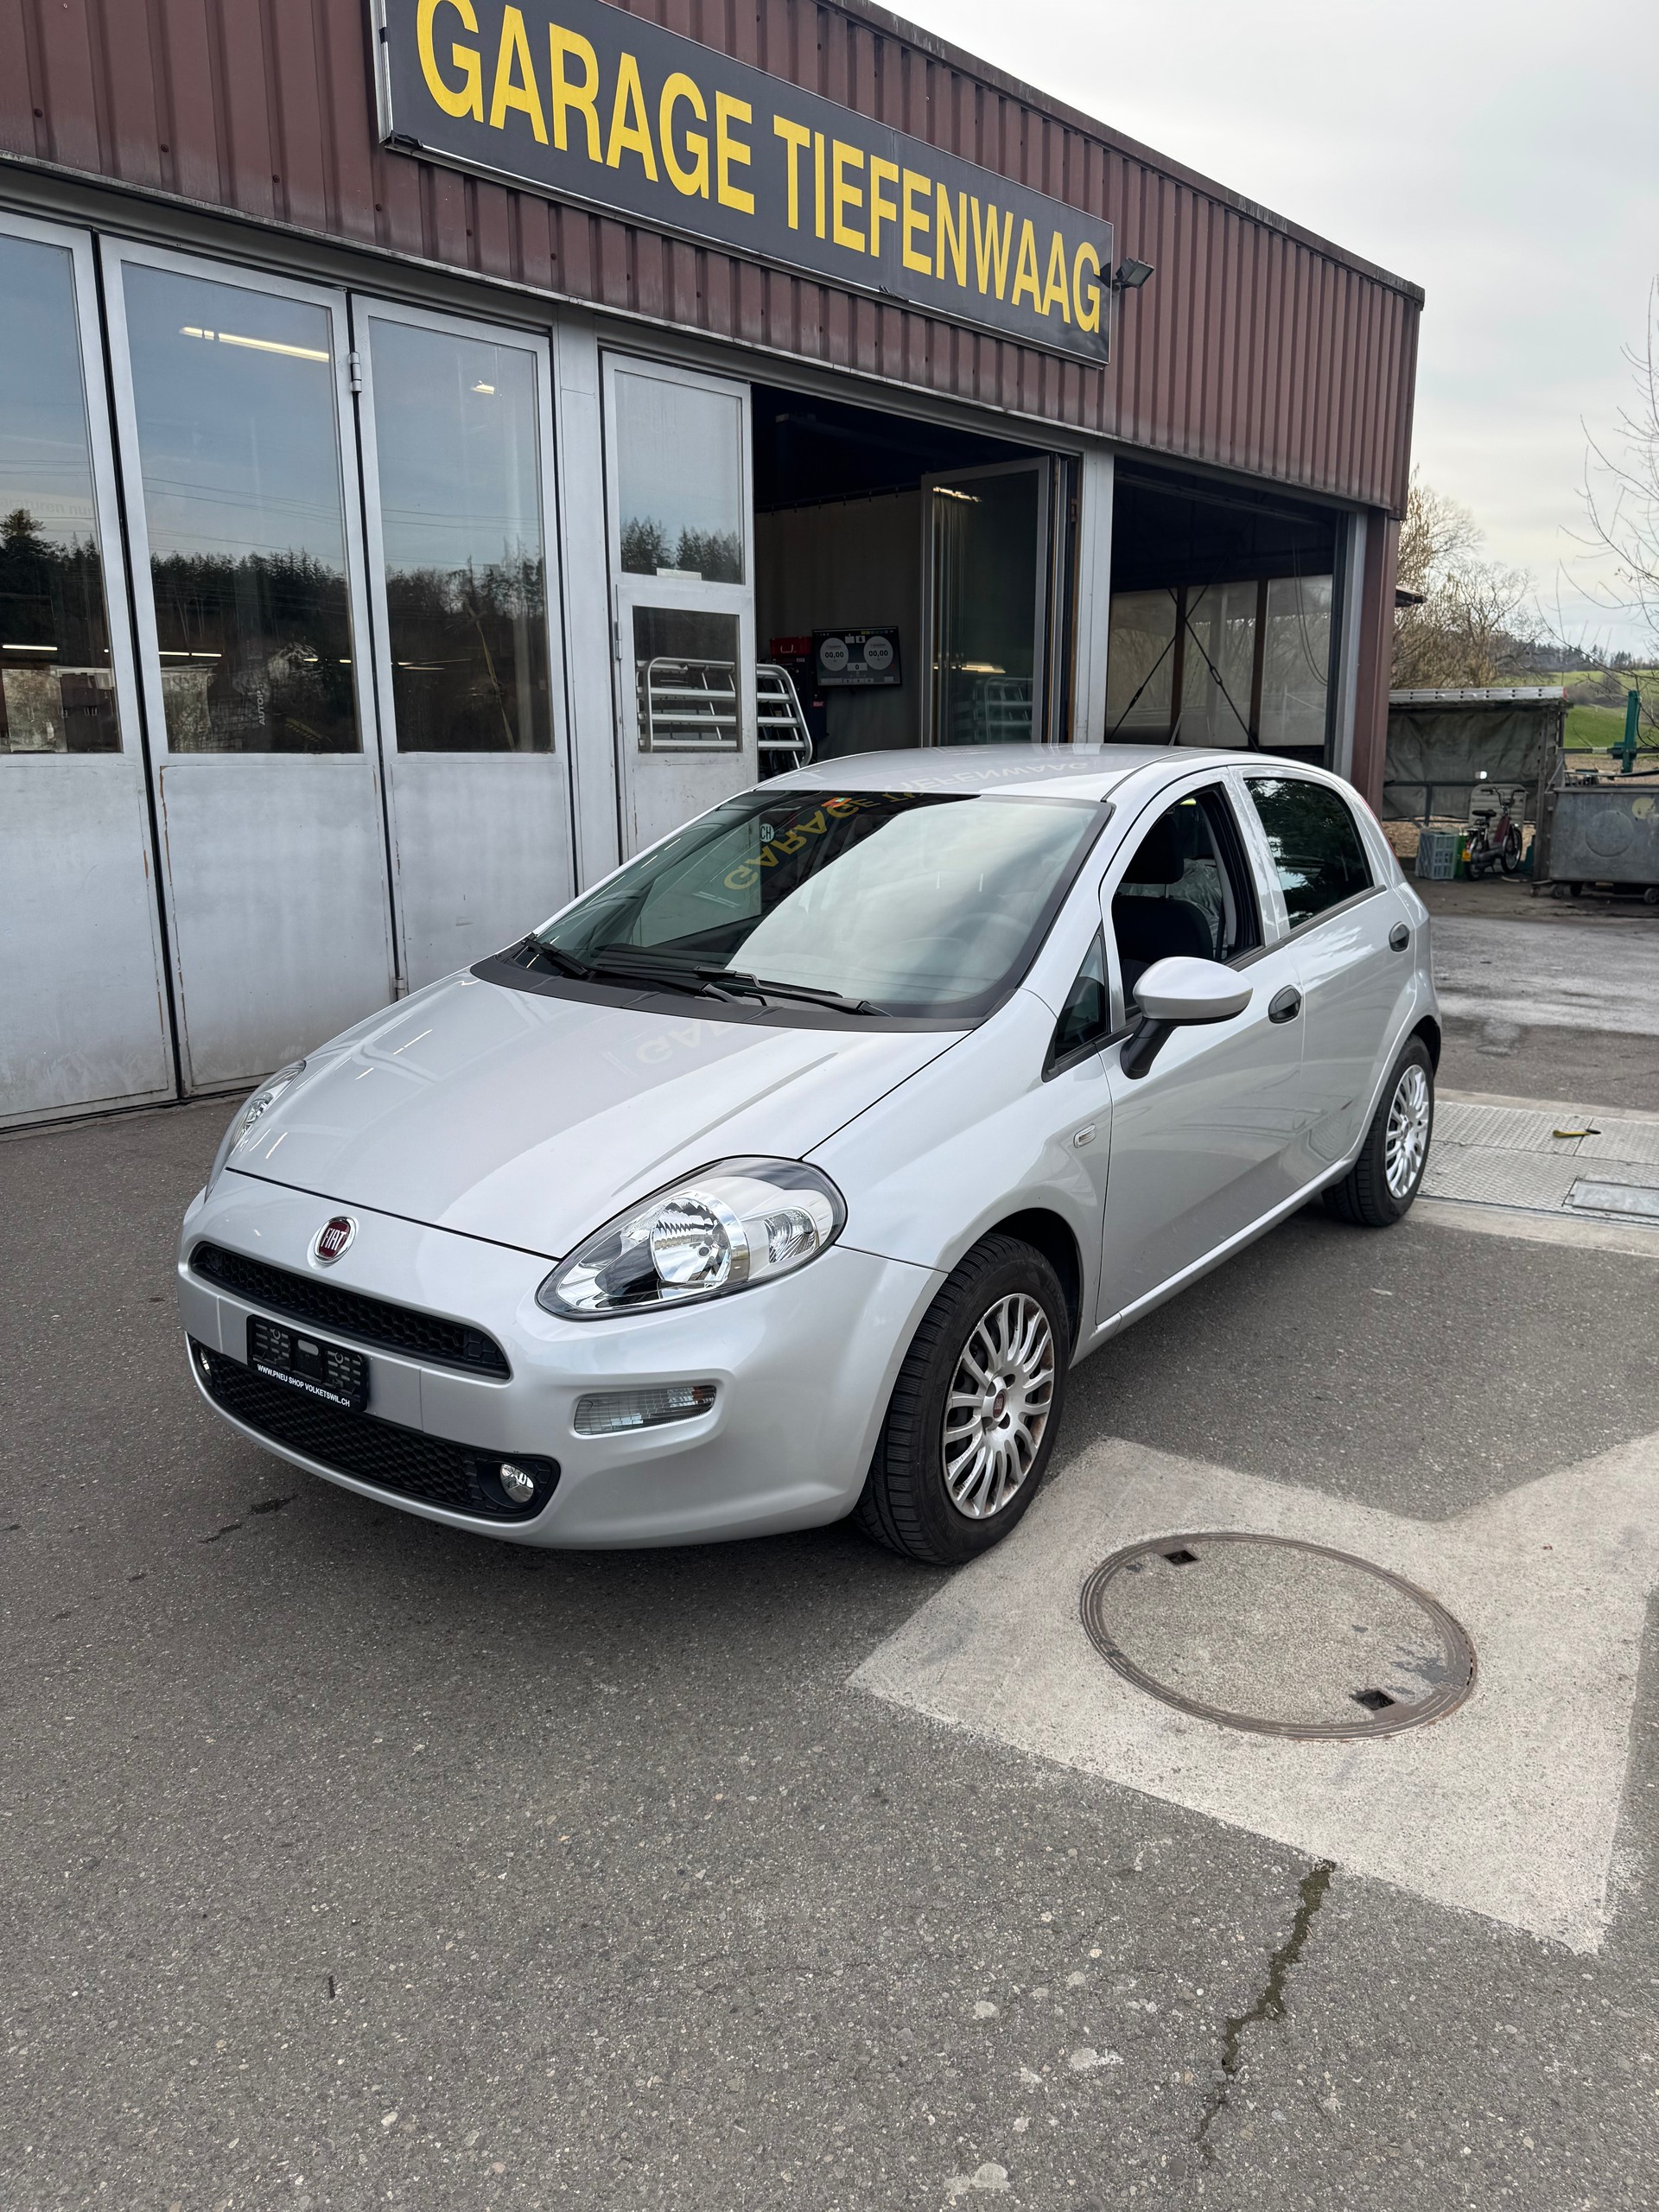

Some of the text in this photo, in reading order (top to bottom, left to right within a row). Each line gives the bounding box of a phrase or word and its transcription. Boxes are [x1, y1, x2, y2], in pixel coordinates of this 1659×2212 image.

[416, 0, 1103, 334] GARAGE TIEFENWAAG
[760, 825, 772, 840] CH
[321, 1227, 347, 1251] FIAT
[257, 1363, 351, 1408] WWW.PNEU SHOP VOLKETSWIL.CH
